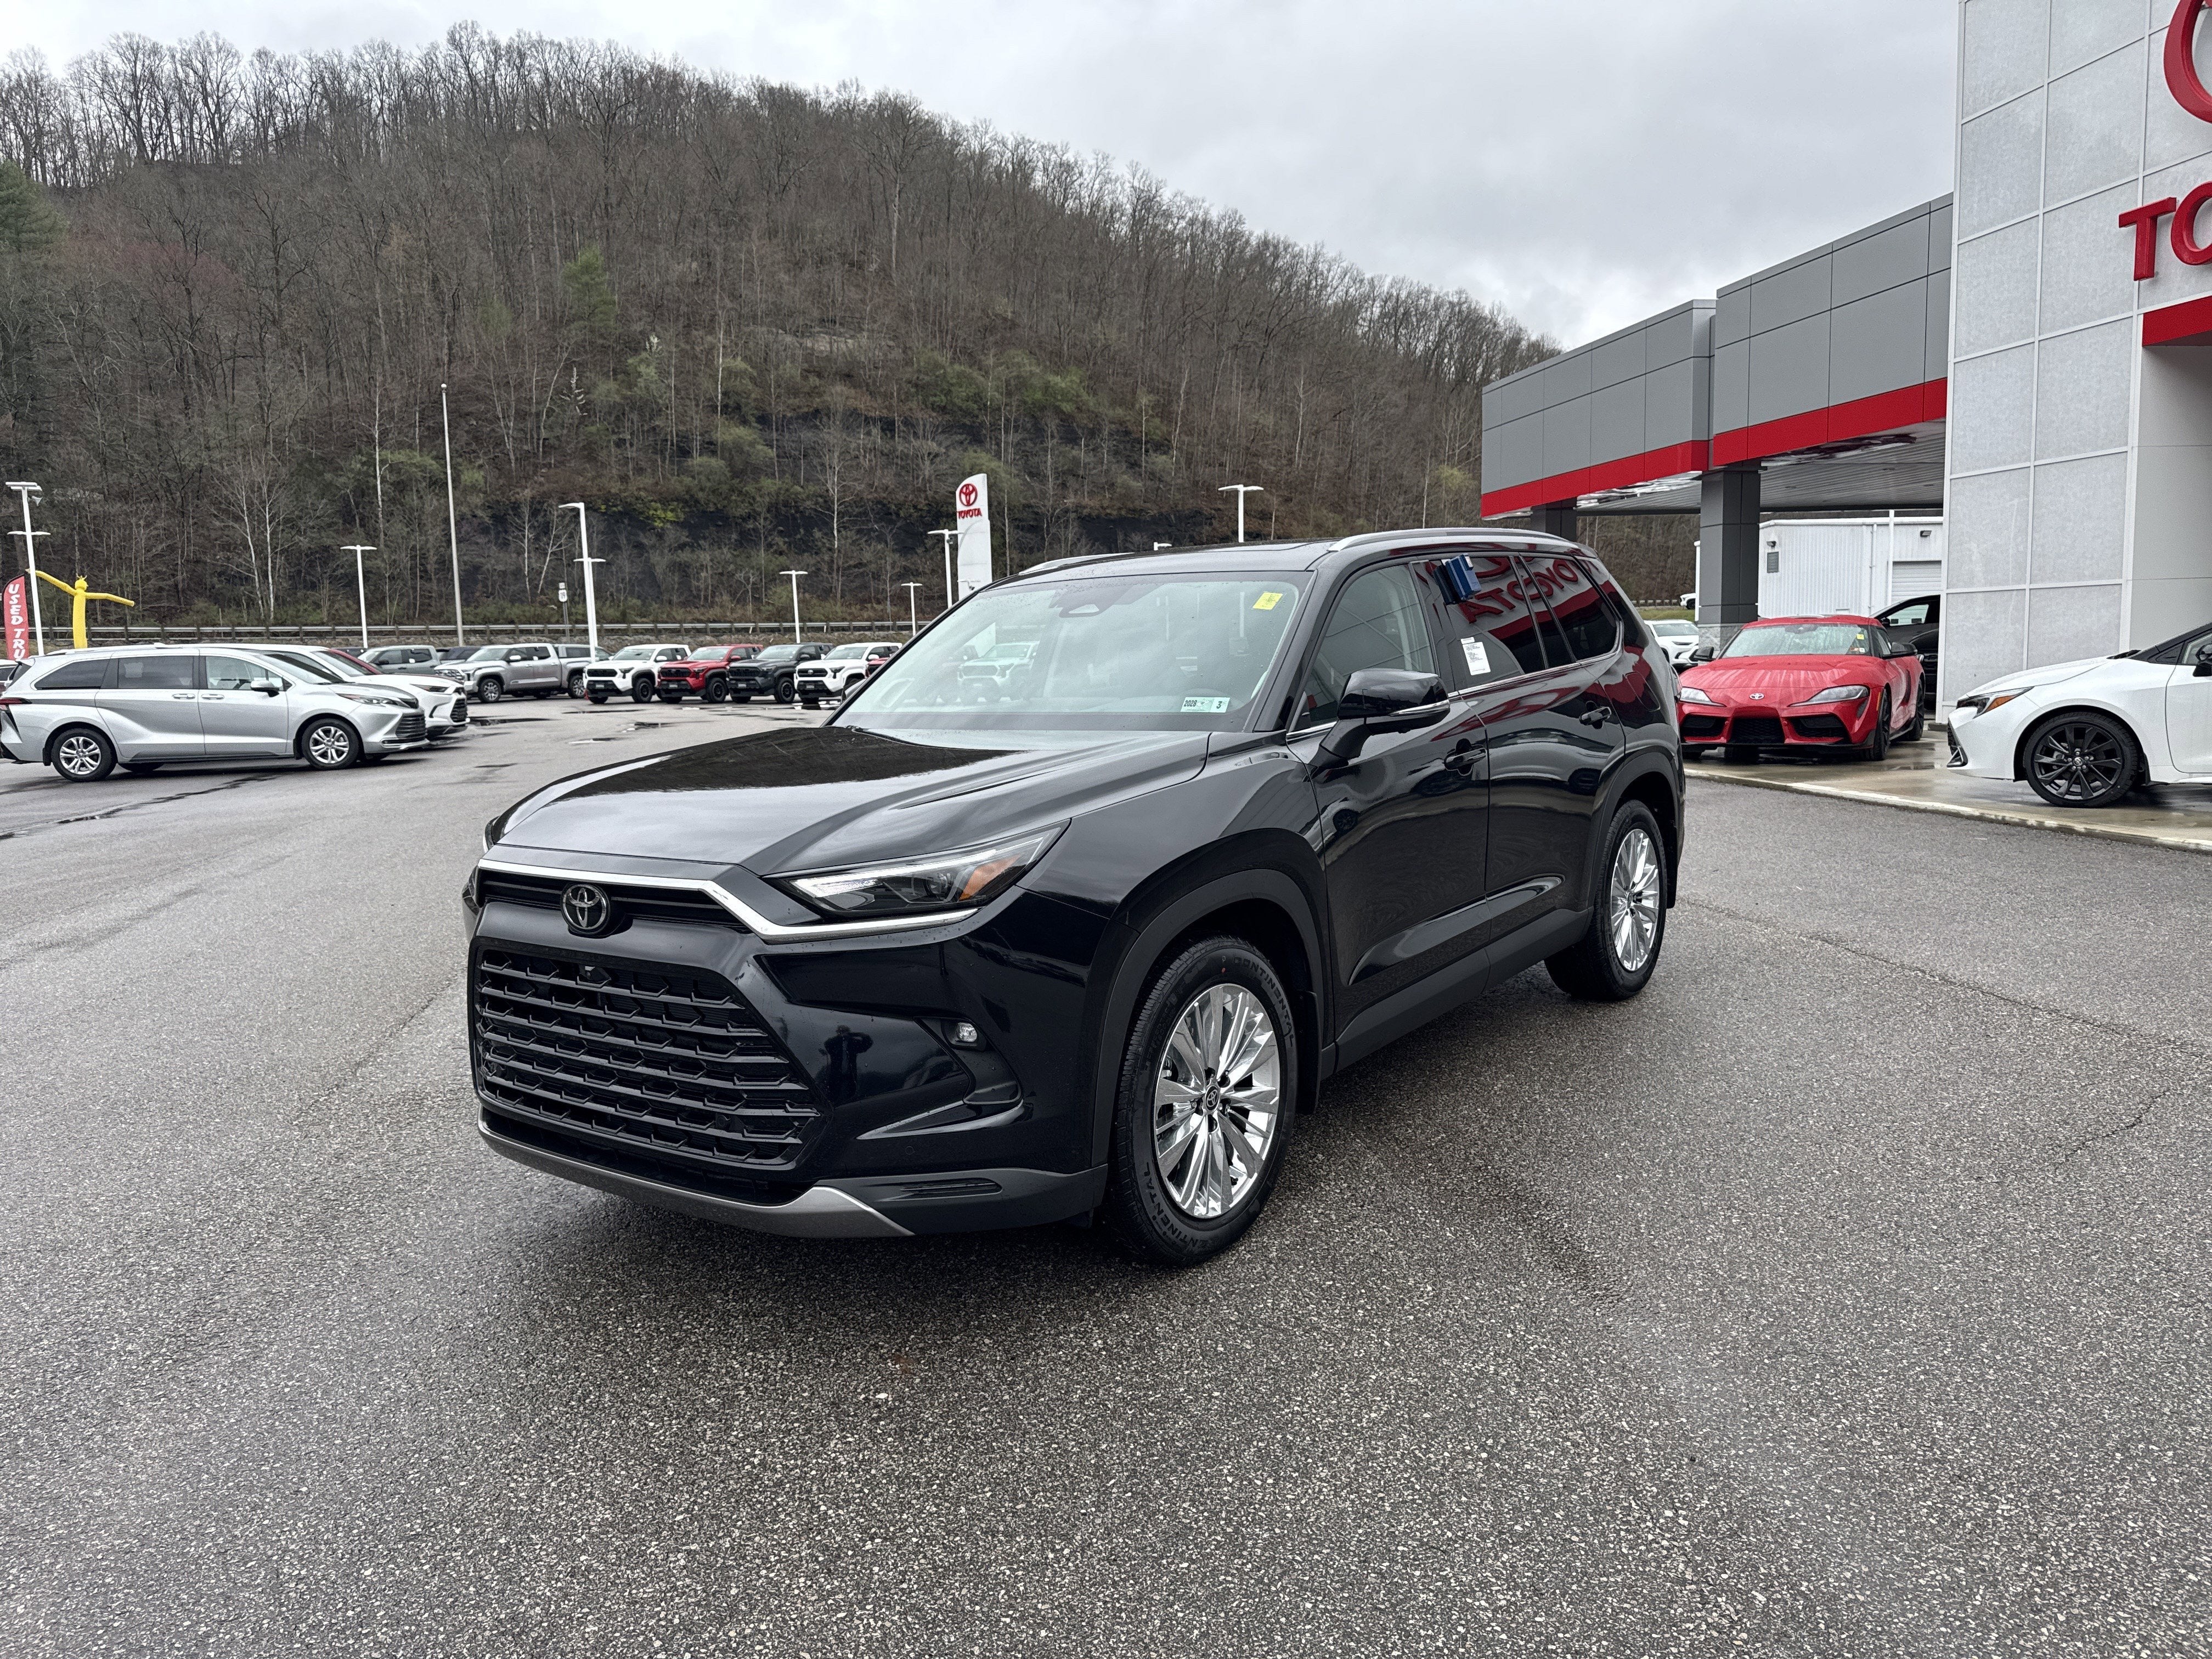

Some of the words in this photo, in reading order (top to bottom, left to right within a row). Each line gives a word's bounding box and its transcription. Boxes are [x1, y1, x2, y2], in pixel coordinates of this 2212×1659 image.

[957, 508, 982, 519] TOYOTA
[8, 584, 24, 625] USED
[13, 628, 25, 661] TRU
[1233, 956, 1295, 1048] CONTINENTAL
[1143, 1161, 1218, 1248] ONTINENTAL
